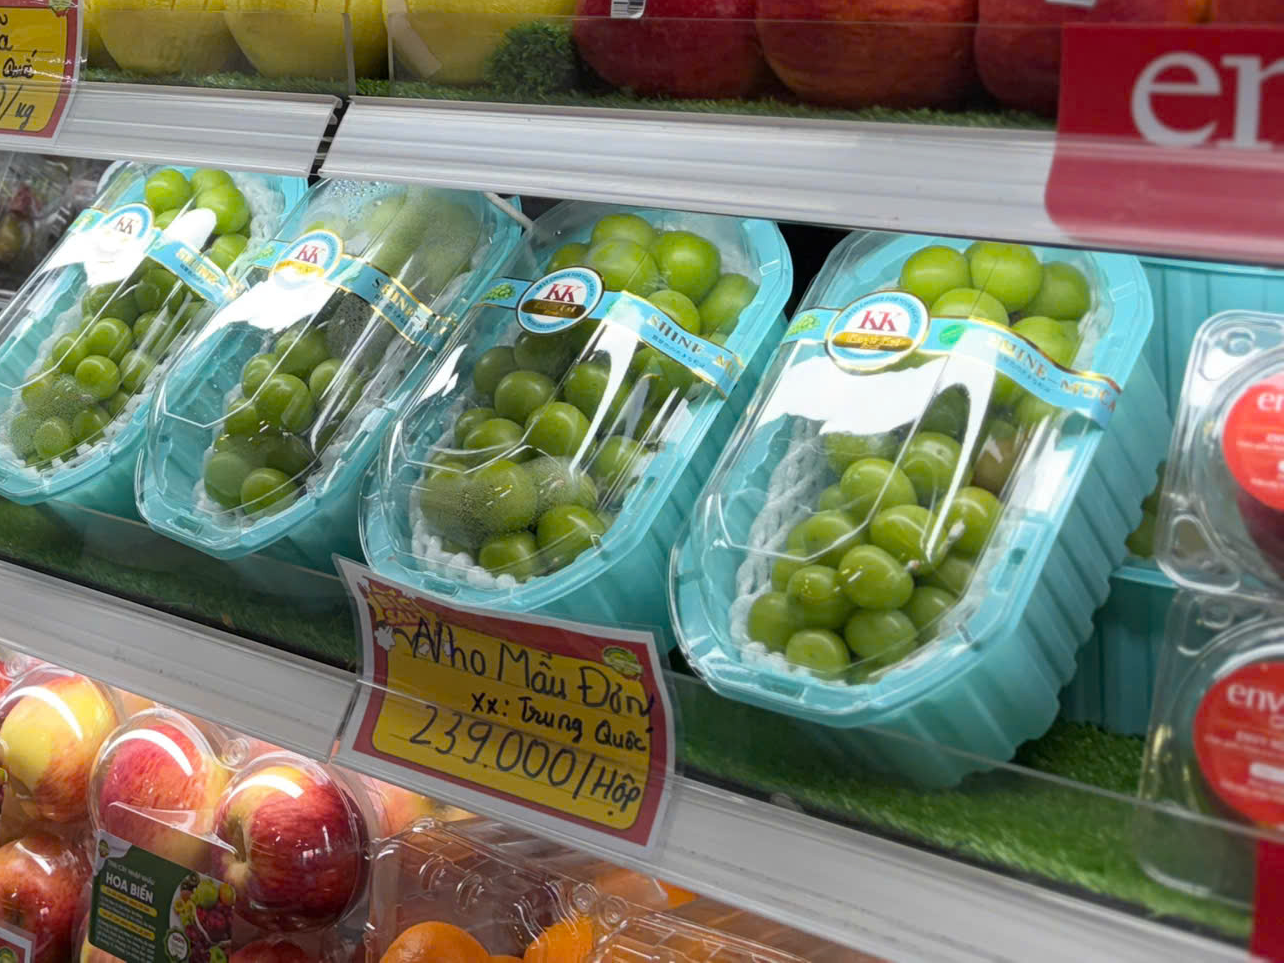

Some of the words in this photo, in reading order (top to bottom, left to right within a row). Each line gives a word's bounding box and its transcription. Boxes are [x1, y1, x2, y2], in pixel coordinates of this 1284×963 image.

[295, 244, 323, 265] KK
[543, 283, 580, 303] KK
[857, 310, 900, 332] KK
[647, 314, 706, 354] SHINE
[518, 695, 583, 743] Trung
[106, 871, 128, 893] HOA
